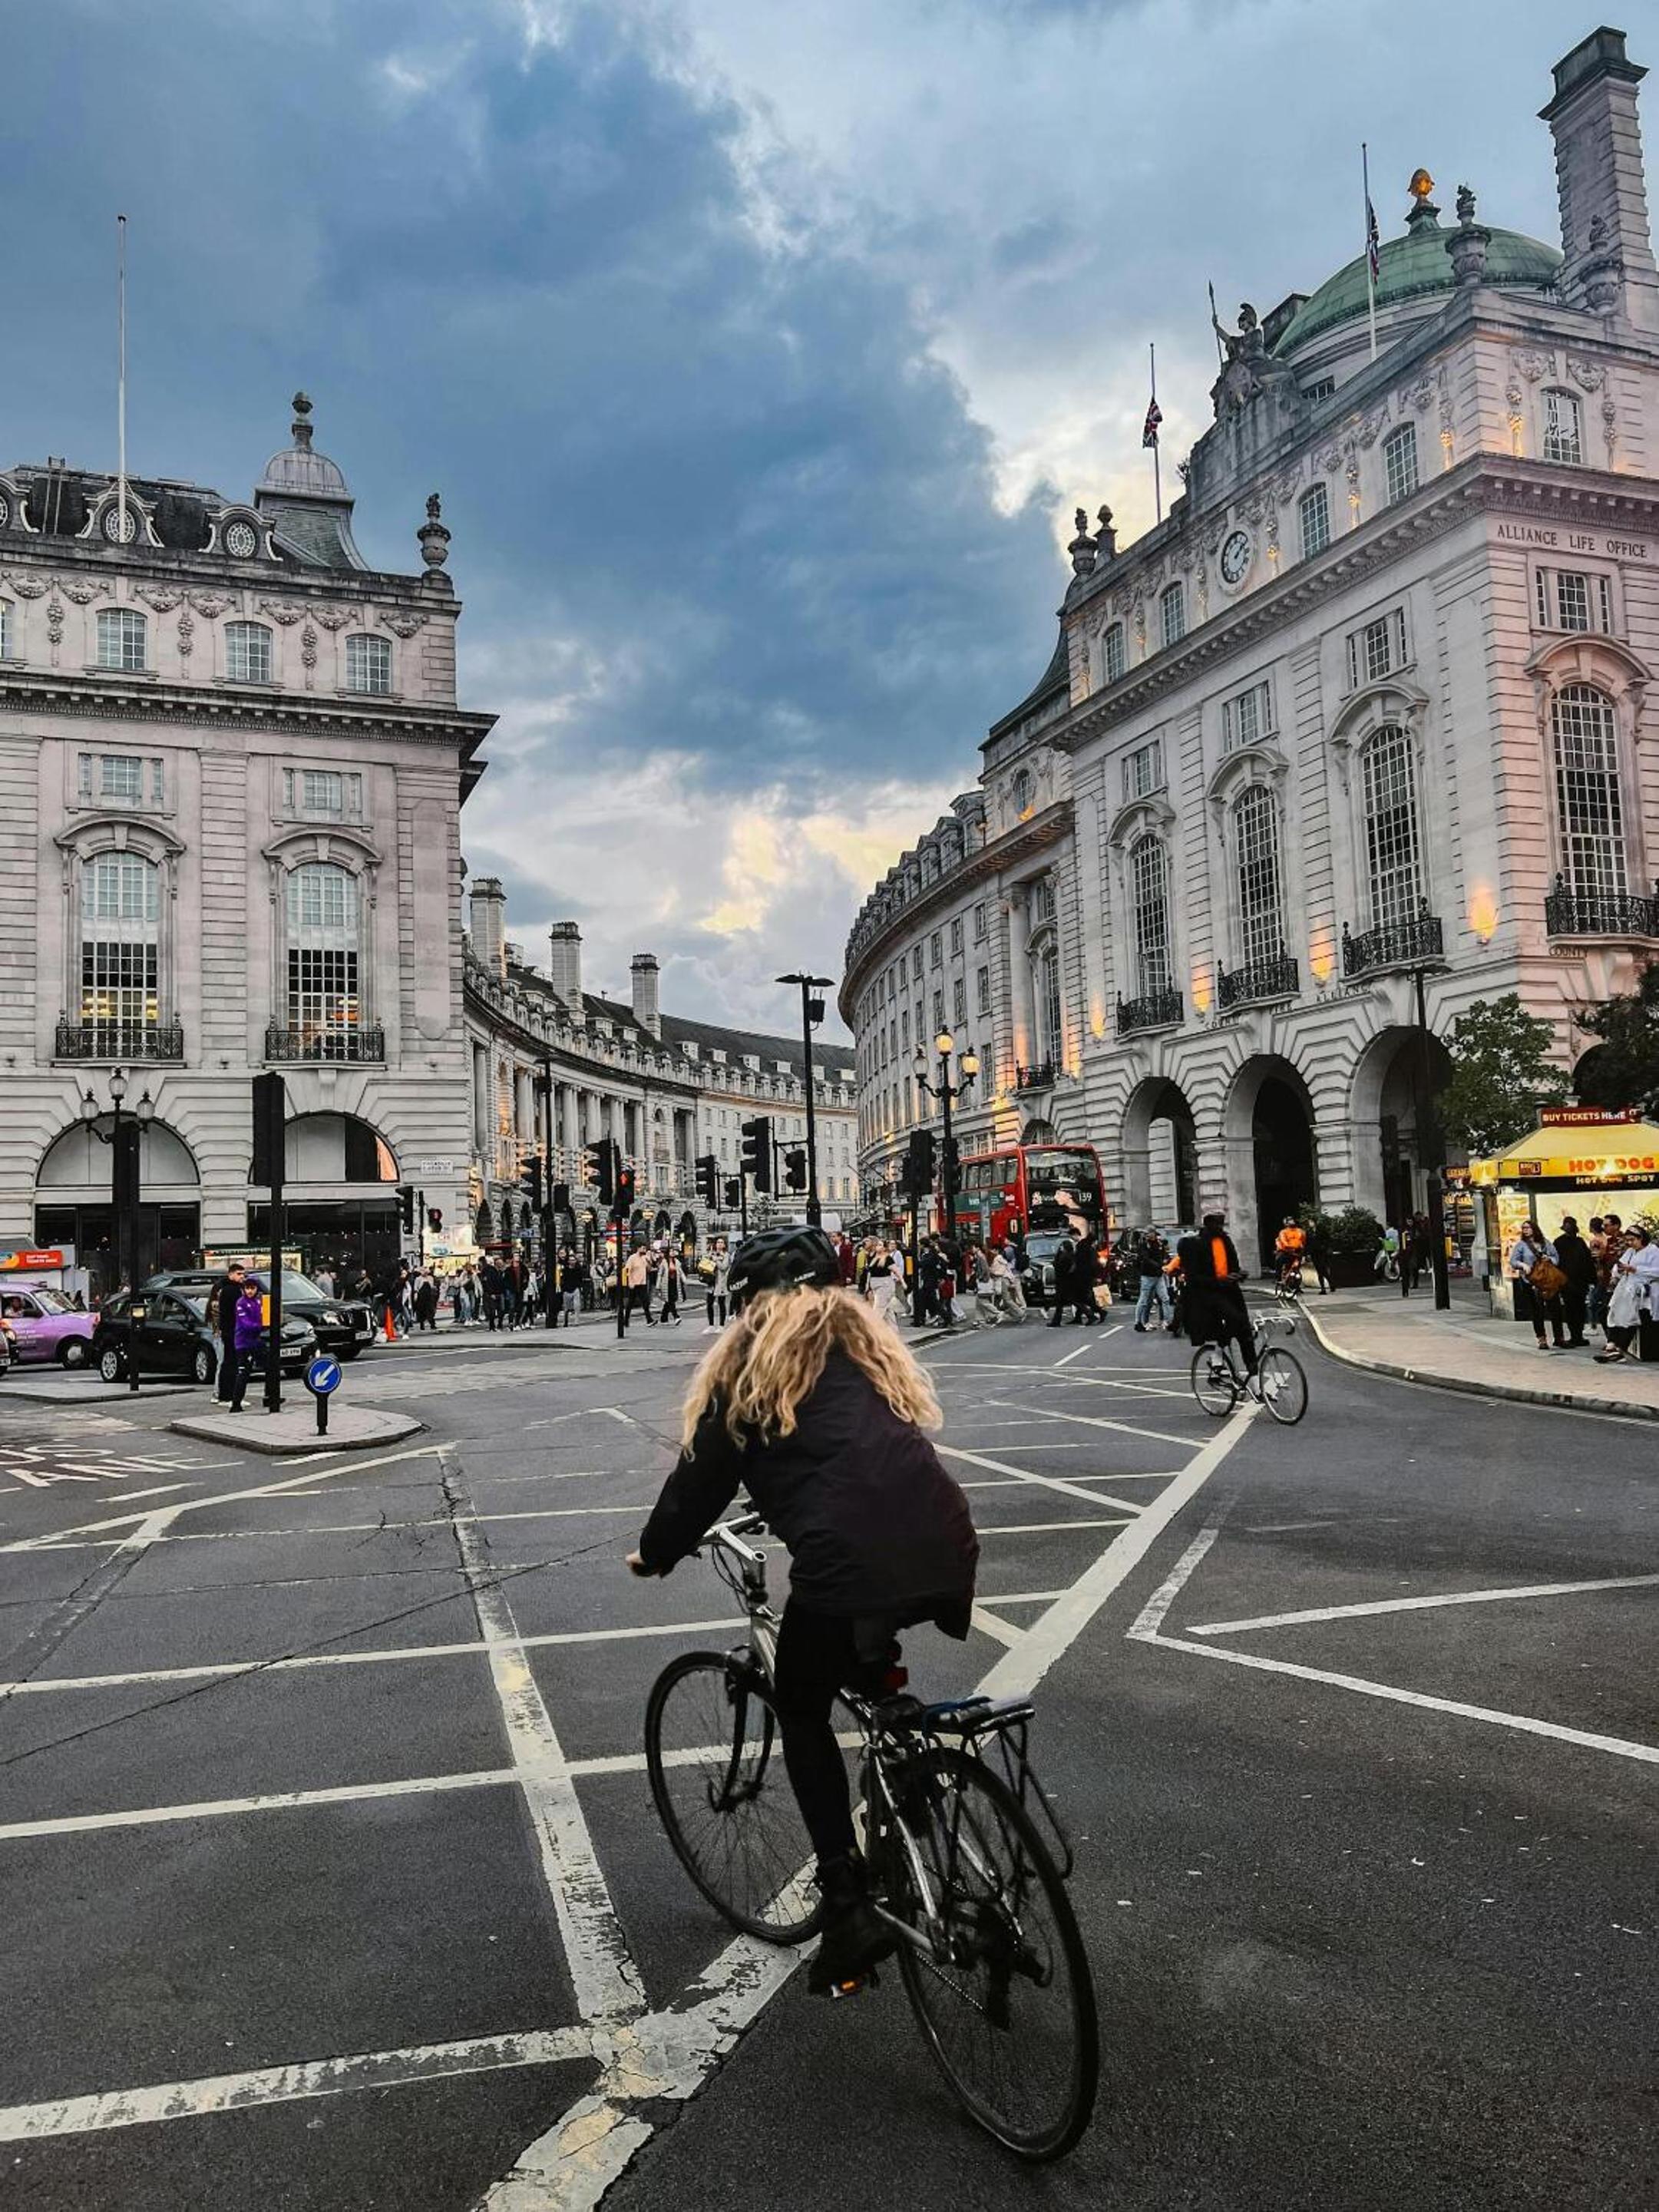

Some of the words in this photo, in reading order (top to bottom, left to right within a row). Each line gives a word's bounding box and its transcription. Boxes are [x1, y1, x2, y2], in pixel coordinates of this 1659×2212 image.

[1497, 524, 1558, 546] ALLIANCE
[1569, 534, 1595, 551] LIFE
[1606, 540, 1647, 558] OFFICE
[1548, 945, 1588, 958] COUNTY
[1315, 984, 1370, 1002] ALLIANC
[1542, 1113, 1561, 1123] BUY
[1562, 1112, 1601, 1122] TICKETS
[1601, 1111, 1627, 1120] HERE
[1568, 1158, 1607, 1172] HOT
[1614, 1156, 1655, 1171] DOG
[1575, 1176, 1598, 1185] HOT
[1628, 1174, 1655, 1184] SPOT
[1079, 1192, 1092, 1202] 139
